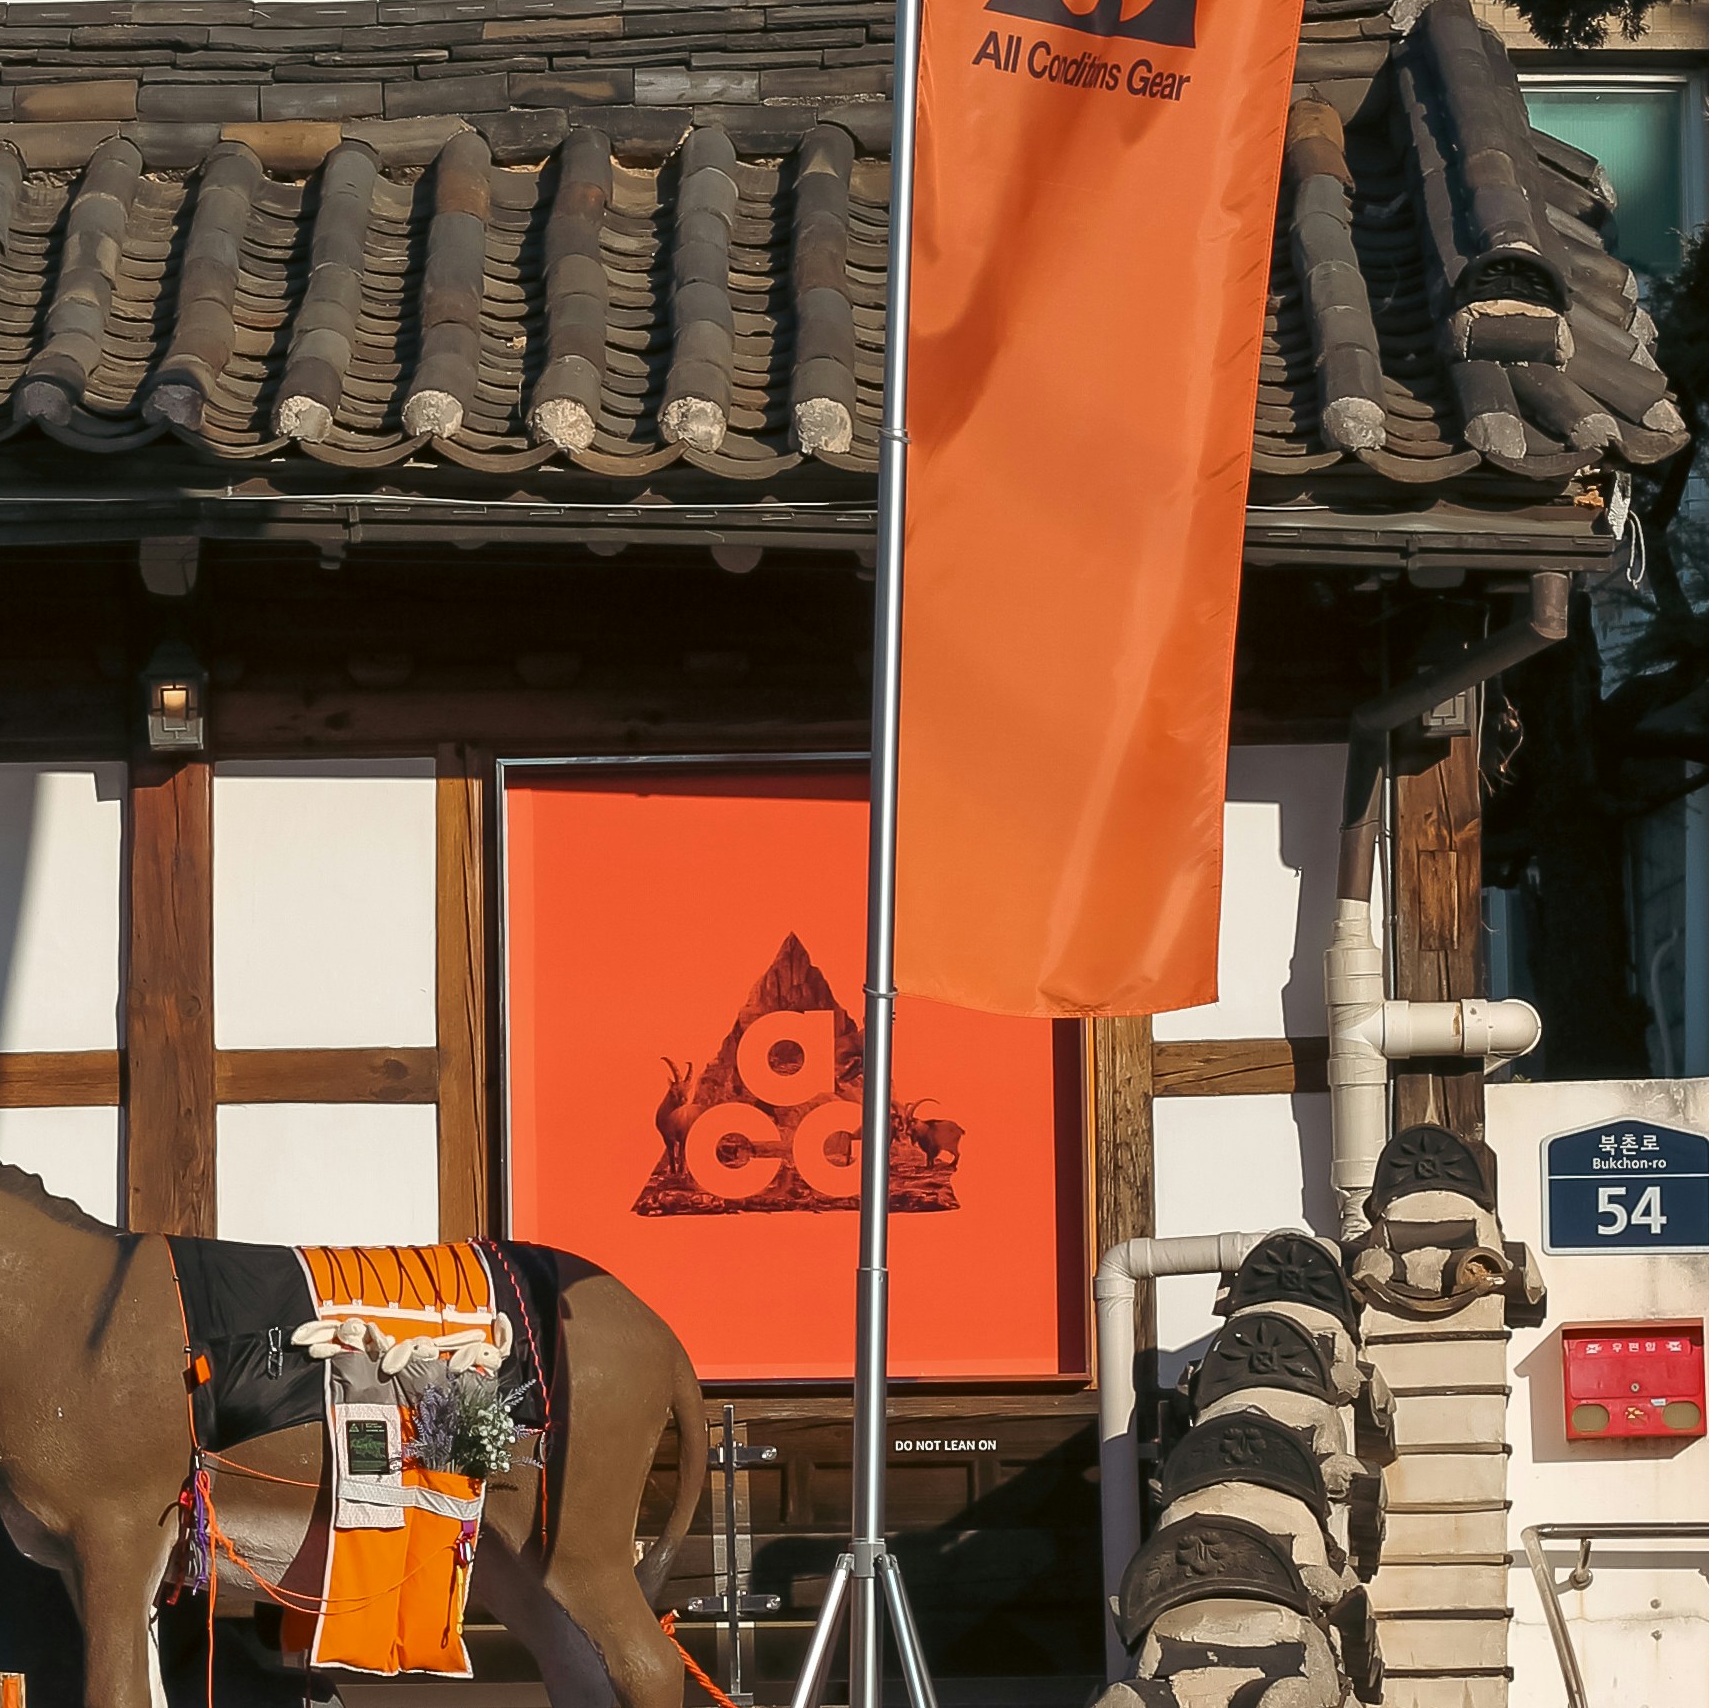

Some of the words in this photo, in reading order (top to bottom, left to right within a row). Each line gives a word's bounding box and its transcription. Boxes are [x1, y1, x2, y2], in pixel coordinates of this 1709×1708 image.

[971, 30, 1023, 74] All
[1126, 58, 1191, 102] Gear
[1598, 1134, 1660, 1156] 북촌로
[1592, 1157, 1667, 1169] Bukchon-ro
[1597, 1186, 1667, 1235] 54
[895, 1440, 913, 1451] DO
[915, 1440, 942, 1451] NOT
[944, 1440, 976, 1451] LEAN
[978, 1440, 997, 1451] ON
